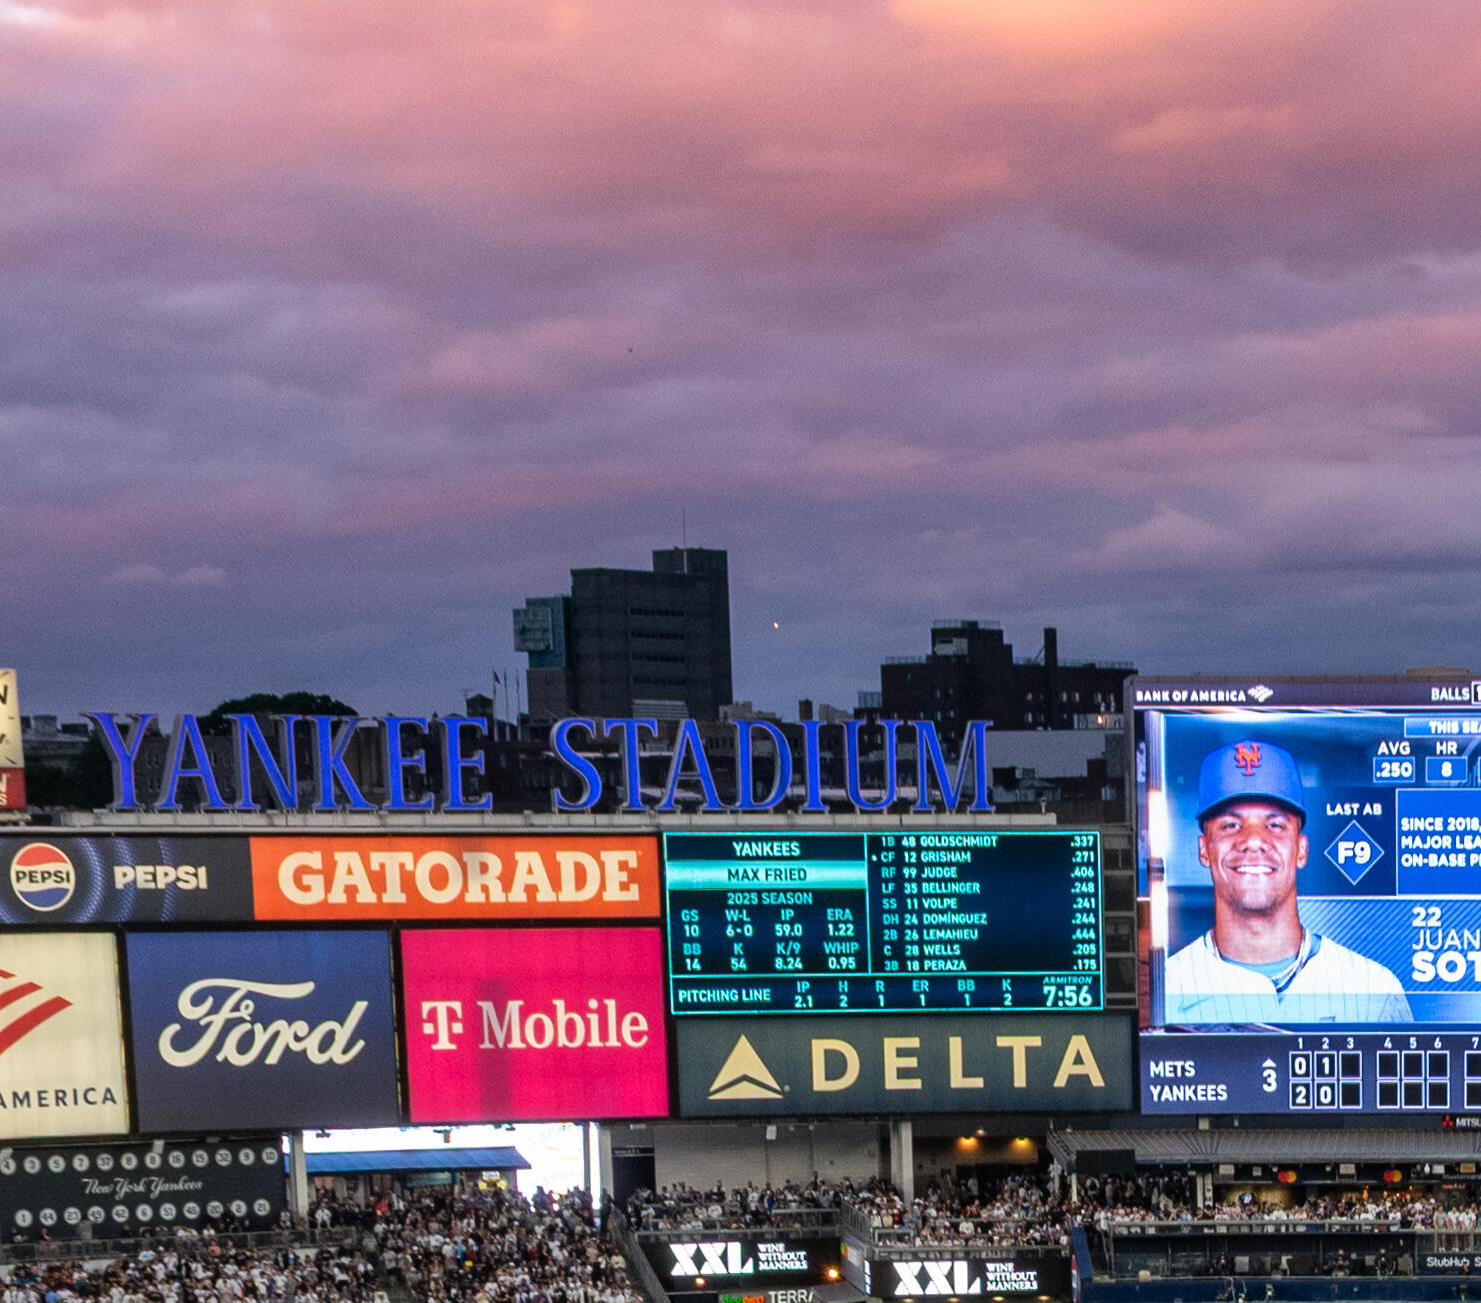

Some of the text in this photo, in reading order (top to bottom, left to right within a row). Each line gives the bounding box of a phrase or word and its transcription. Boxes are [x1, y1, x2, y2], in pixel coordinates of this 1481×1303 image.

[1429, 720, 1458, 733] THIS
[85, 710, 997, 814] YANKEE STADIUM
[1401, 817, 1443, 831] SINCE
[733, 841, 801, 857] YANKEES
[920, 836, 998, 847] GOLDSCHMIDT
[1401, 835, 1452, 849] MAJOR
[1337, 840, 1371, 865] F9
[1401, 854, 1466, 867] ON-BASE
[14, 870, 71, 887] PEPSI
[114, 864, 209, 891] PEPSI
[277, 849, 640, 907] GATORADE
[727, 868, 807, 881] MAX FRIED
[921, 867, 957, 878] JUDGE
[922, 883, 980, 894] BELLINGER
[1412, 908, 1441, 927] 22
[1412, 929, 1481, 950] JUAN
[924, 960, 967, 971] PERAZA
[1043, 985, 1093, 1007] 7:56
[157, 978, 369, 1068] Ford
[479, 999, 649, 1051] Mobile
[811, 1034, 1107, 1093] DELTA
[1150, 1061, 1196, 1078] METS
[1150, 1085, 1228, 1102] YANKEES
[670, 1242, 754, 1276] XXL
